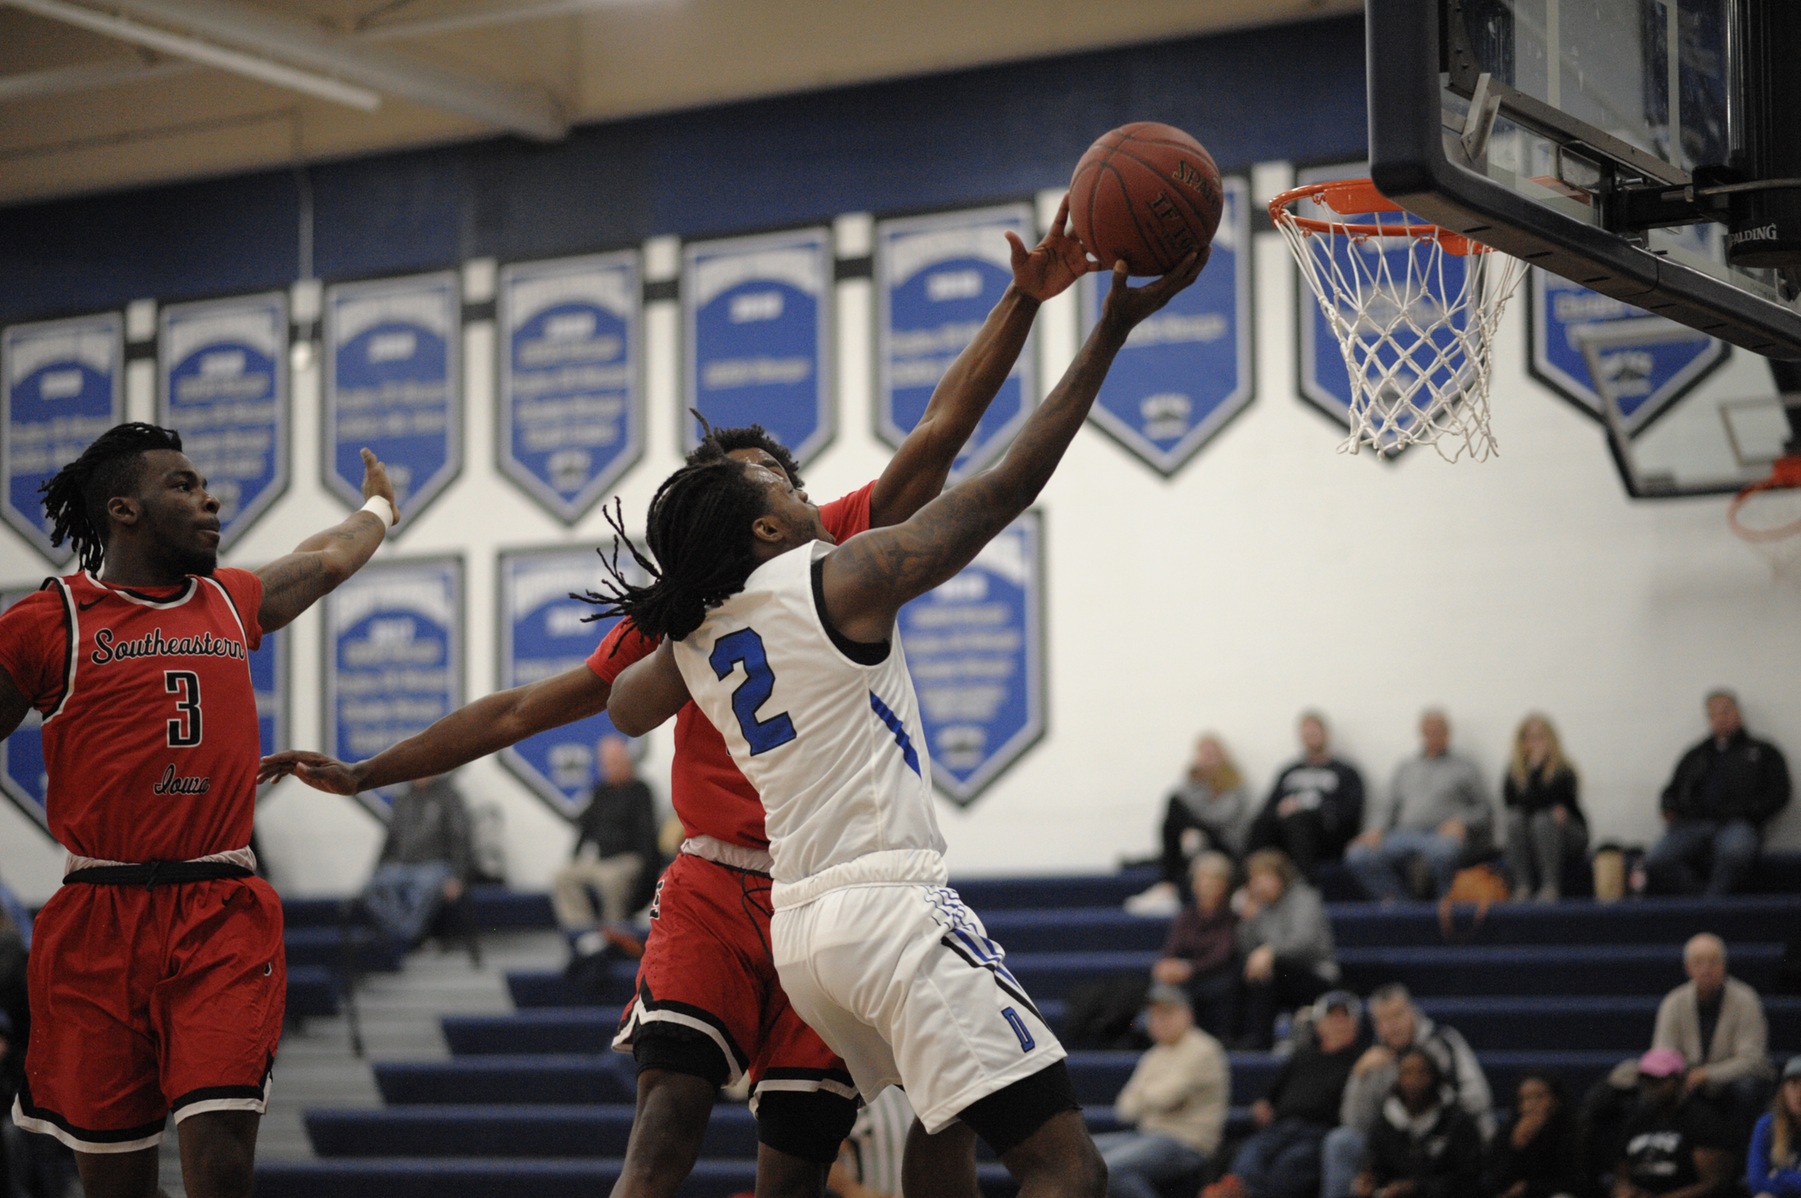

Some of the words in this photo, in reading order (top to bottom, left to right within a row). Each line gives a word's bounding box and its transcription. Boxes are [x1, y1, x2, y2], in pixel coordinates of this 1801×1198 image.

[92, 628, 245, 665] Southeastern
[164, 670, 202, 748] 3
[709, 627, 797, 756] 2
[154, 763, 210, 795] Iowa
[1001, 1006, 1035, 1053] D
